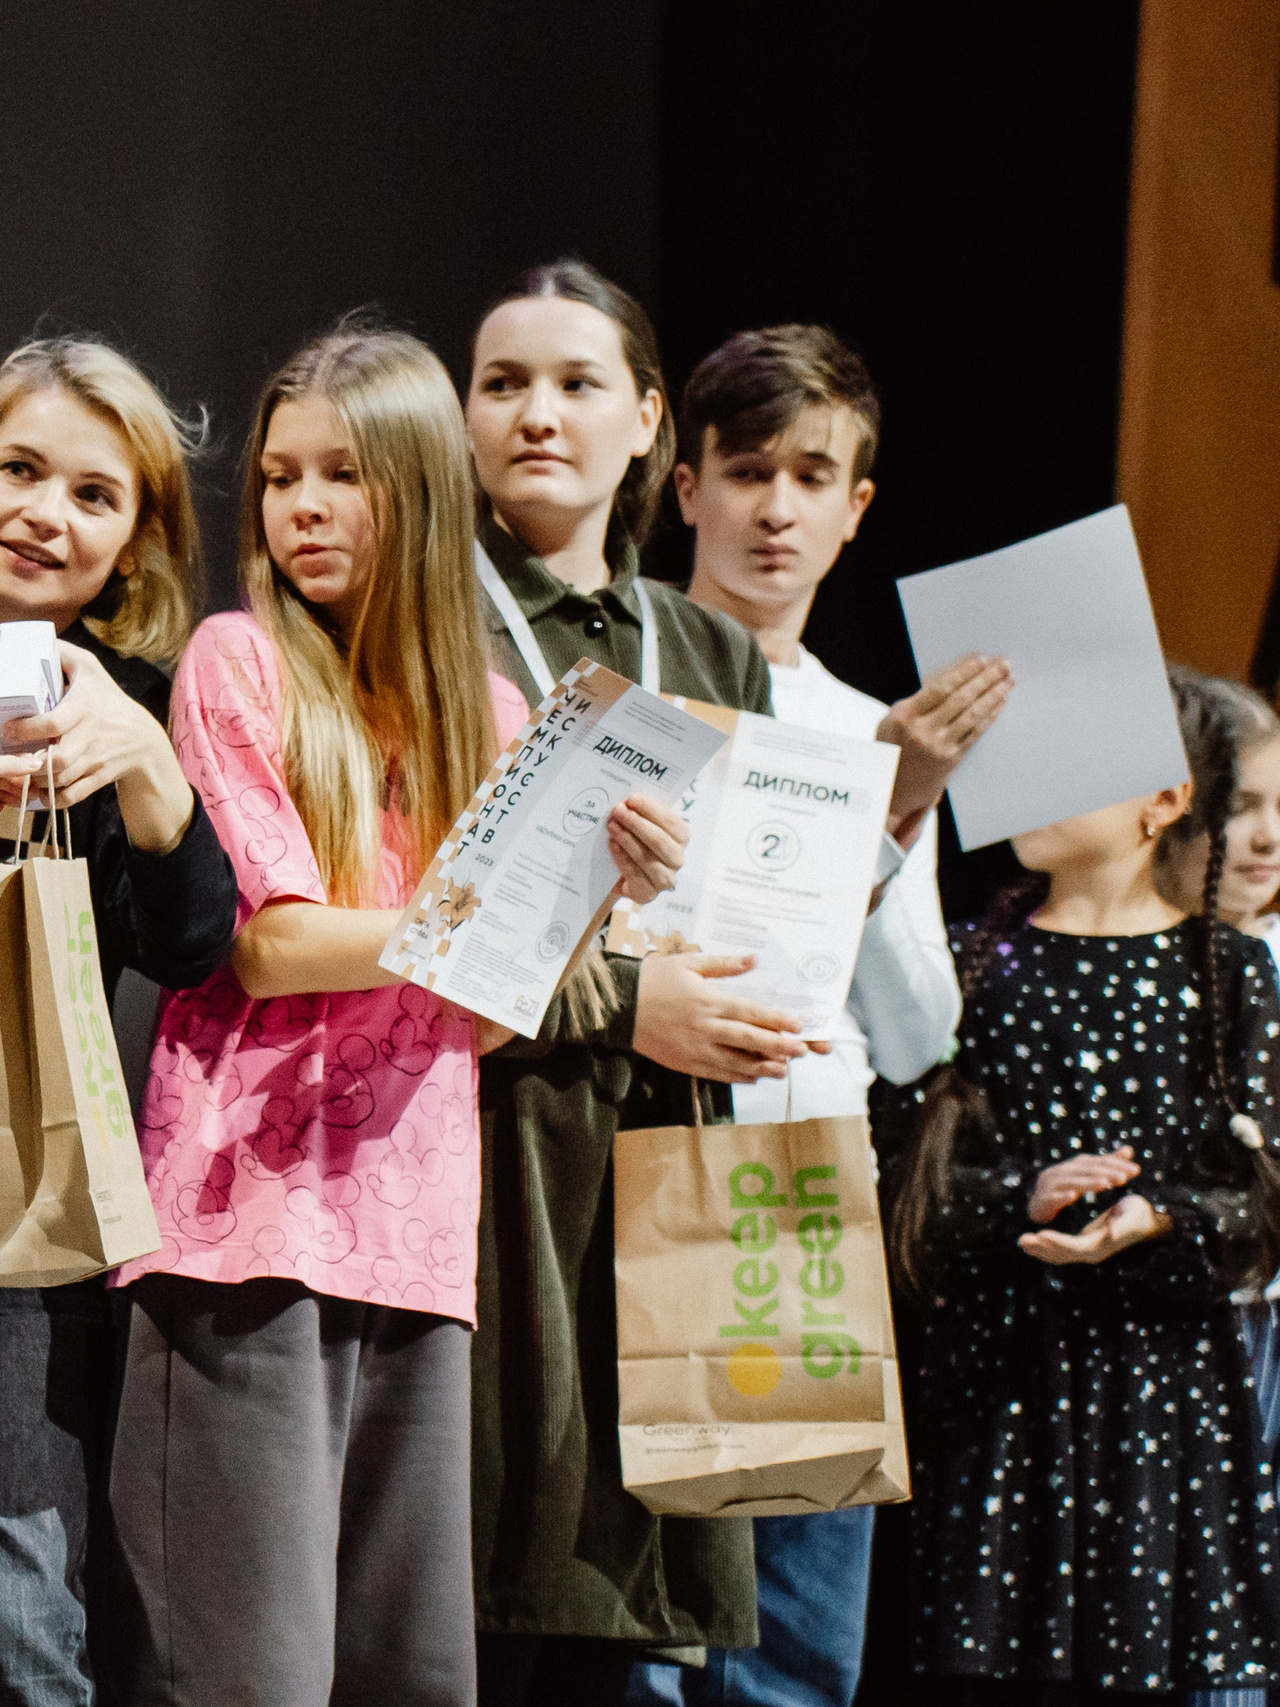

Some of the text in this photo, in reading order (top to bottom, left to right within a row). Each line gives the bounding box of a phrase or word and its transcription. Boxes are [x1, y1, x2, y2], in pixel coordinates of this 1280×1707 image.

[456, 690, 578, 856] ЧЕМПИОНАТ
[480, 700, 592, 844] ИСКУССТВ
[592, 735, 669, 781] ДИПЛОМ
[743, 770, 850, 805] ДИПЛОМ
[474, 853, 495, 867] 2023
[567, 809, 601, 825] УЧАСТИЕ
[718, 1160, 789, 1339] keep
[792, 1164, 862, 1380] green
